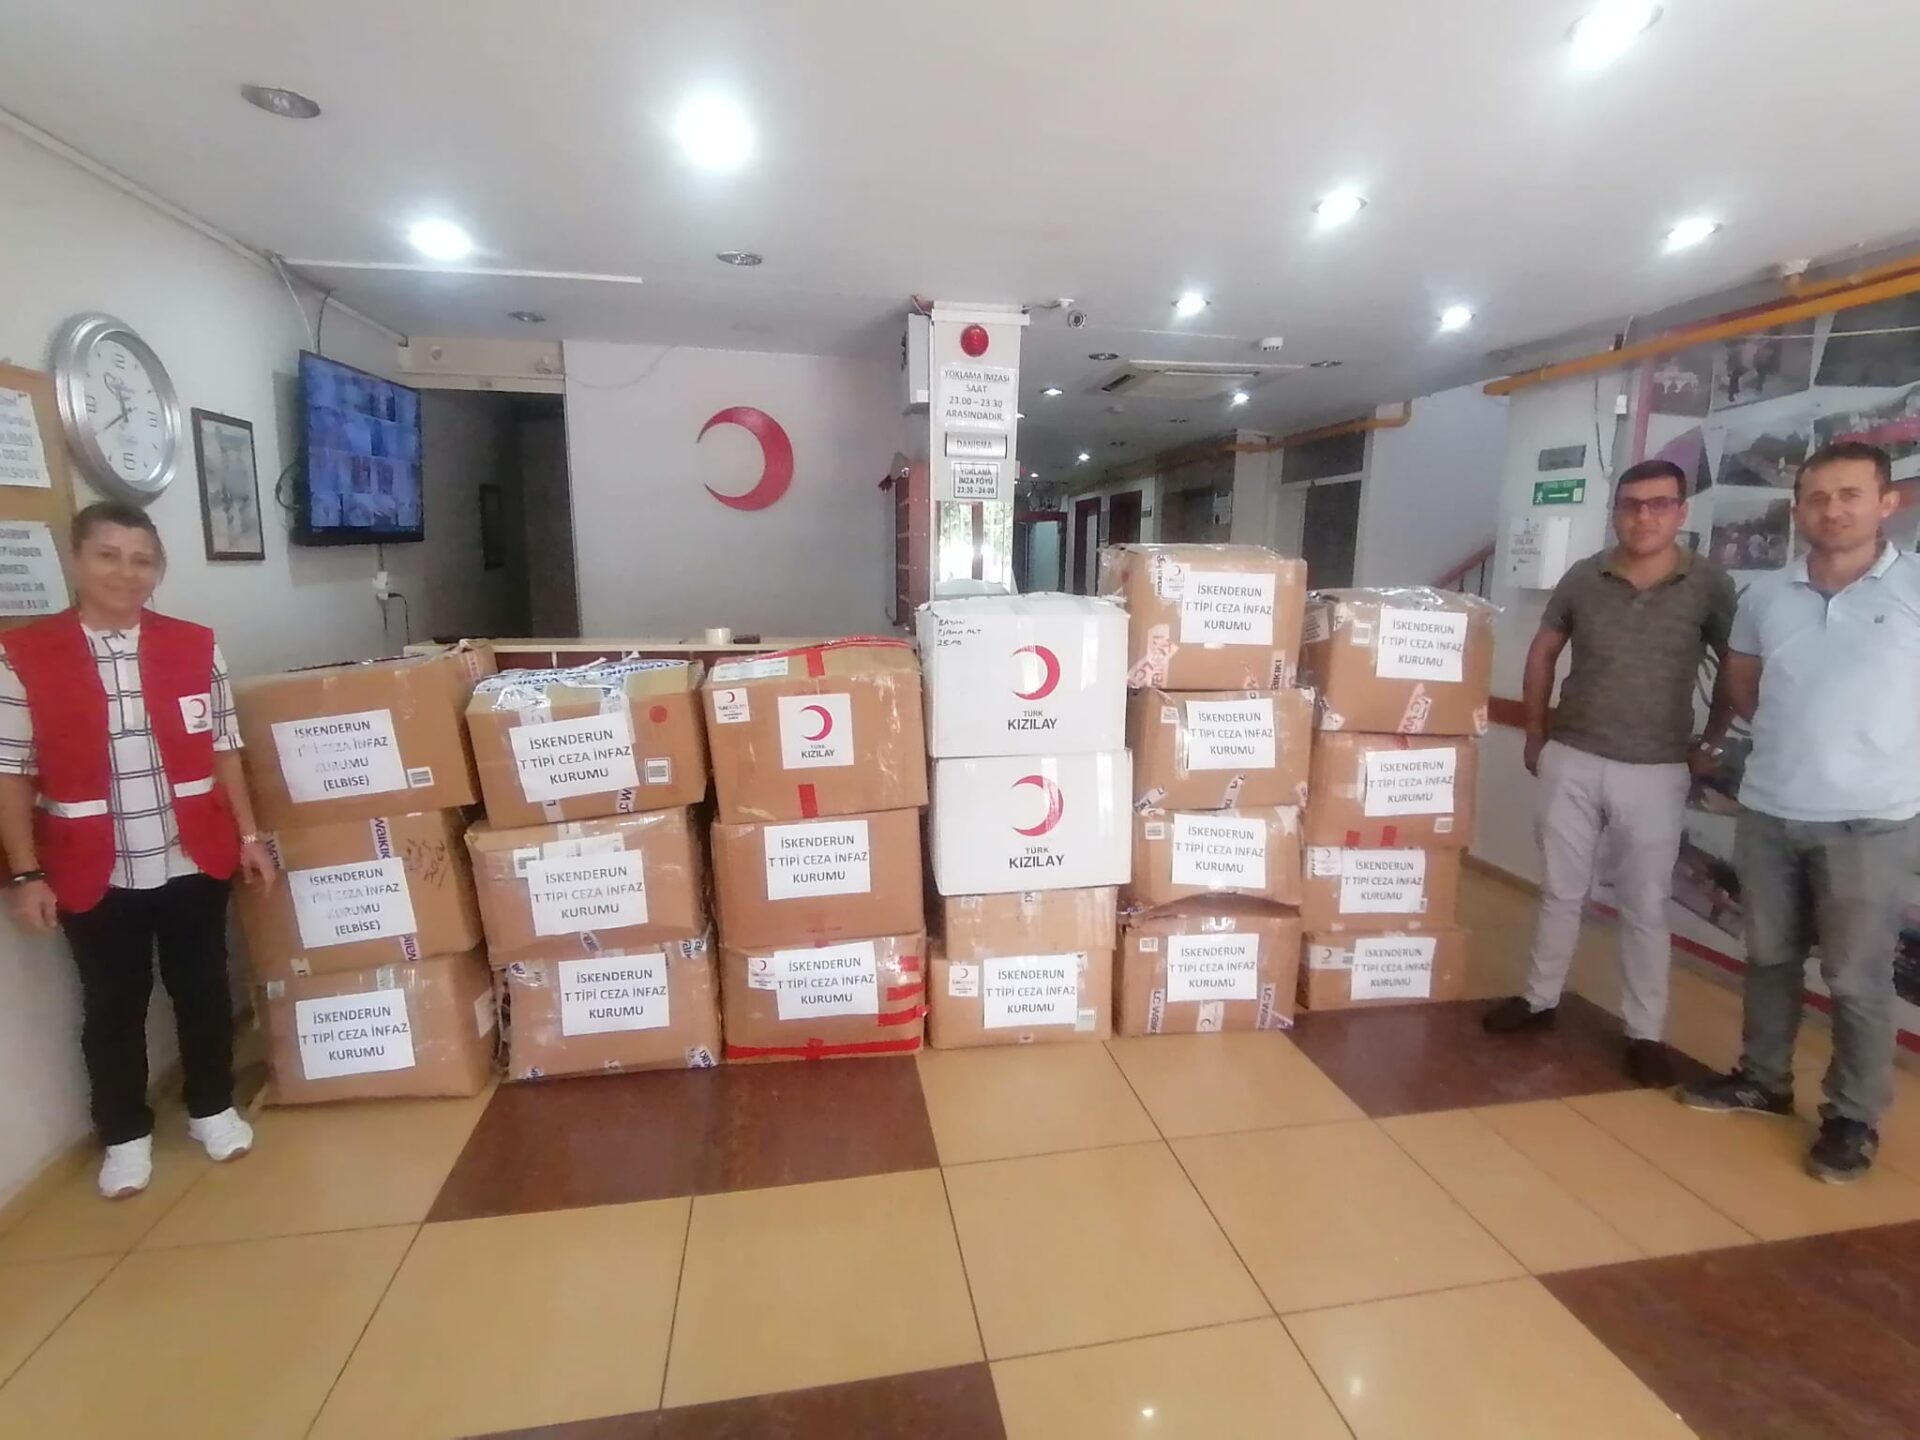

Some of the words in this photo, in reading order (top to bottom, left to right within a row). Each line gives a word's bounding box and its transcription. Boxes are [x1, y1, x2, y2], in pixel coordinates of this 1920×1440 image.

[945, 370, 981, 380] YOKLAMA
[1198, 585, 1262, 597] İSKENDERUN
[1185, 602, 1190, 611] T
[1194, 602, 1213, 612] TİPİ
[1215, 604, 1240, 613] CEZA
[1243, 604, 1272, 615] İNFAZ
[1205, 620, 1251, 631] KURUMU
[1393, 620, 1455, 634] İSKENDERUN
[1410, 638, 1433, 649] CEZA
[1399, 656, 1443, 667] KURUMU
[1199, 712, 1261, 722] İSKENDERUN
[295, 720, 371, 739] İSKENDERUN
[1007, 718, 1058, 730] KIZILAY
[530, 729, 613, 749] İSKENDERUN
[1191, 728, 1196, 737] T
[1218, 728, 1242, 738] CEZA
[1245, 728, 1272, 738] İNFAZ
[801, 750, 835, 758] KIZILAY
[1210, 746, 1254, 754] KURUMU
[520, 760, 526, 770] T
[530, 755, 555, 769] TİPİ
[558, 752, 590, 765] CEZA
[594, 746, 631, 760] İNFAZ
[1381, 761, 1444, 772] İSKENDERUN
[550, 768, 609, 784] KURUMU
[1379, 779, 1396, 788] TİPİ
[1398, 777, 1422, 787] CEZA
[1425, 776, 1453, 785] İNFAZ
[1388, 793, 1432, 803] KURUMU
[1188, 826, 1254, 840] İSKENDERUN
[781, 834, 855, 848] İSKENDERUN
[1176, 842, 1181, 850] T
[1185, 844, 1203, 853] TİPİ
[1207, 845, 1232, 855] CEZA
[769, 858, 775, 867] T
[779, 855, 800, 866] TİPİ
[803, 854, 830, 865] CEZA
[835, 851, 868, 863] İNFAZ
[1009, 855, 1064, 869] KIZILAY
[1196, 861, 1244, 872] KURUMU
[1356, 861, 1414, 870] İSKENDERUN
[310, 868, 383, 886] İSKENDERUN
[546, 866, 627, 884] İSKENDERUN
[793, 871, 845, 883] KURUMU
[1371, 877, 1393, 885] CEZA
[366, 883, 400, 896] İNFAZ
[534, 893, 540, 902] T
[544, 890, 567, 902] TİPİ
[571, 889, 603, 899] CEZA
[606, 882, 644, 896] İNFAZ
[1361, 892, 1402, 900] KURUMU
[562, 904, 619, 919] KURUMU
[1181, 946, 1245, 958] İSKENDERUN
[789, 957, 861, 972] İSKENDERUN
[1169, 964, 1174, 972] T
[1179, 963, 1197, 972] TİPİ
[1200, 963, 1223, 971] CEZA
[1227, 962, 1255, 971] İNFAZ
[1380, 963, 1402, 971] CEZA
[577, 969, 652, 983] İSKENDERUN
[998, 969, 1064, 980] İSKENDERUN
[787, 978, 807, 989] TİPİ
[811, 976, 838, 987] CEZA
[1189, 979, 1235, 988] KURUMU
[565, 992, 571, 1001] T
[576, 990, 596, 1001] TİPİ
[600, 988, 629, 1000] CEZA
[986, 988, 991, 996] T
[996, 987, 1014, 996] TİPİ
[1018, 986, 1043, 996] CEZA
[1046, 985, 1075, 995] İNFAZ
[801, 993, 853, 1005] KURUMU
[589, 1006, 644, 1019] KURUMU
[1008, 1003, 1055, 1014] KURUMU
[314, 1006, 391, 1024] İSKENDERUN
[301, 1035, 308, 1045] T
[313, 1031, 334, 1044] TİPİ
[338, 1029, 368, 1042] CEZA
[372, 1022, 408, 1037] İNFAZ
[329, 1046, 385, 1061] KURUMU
